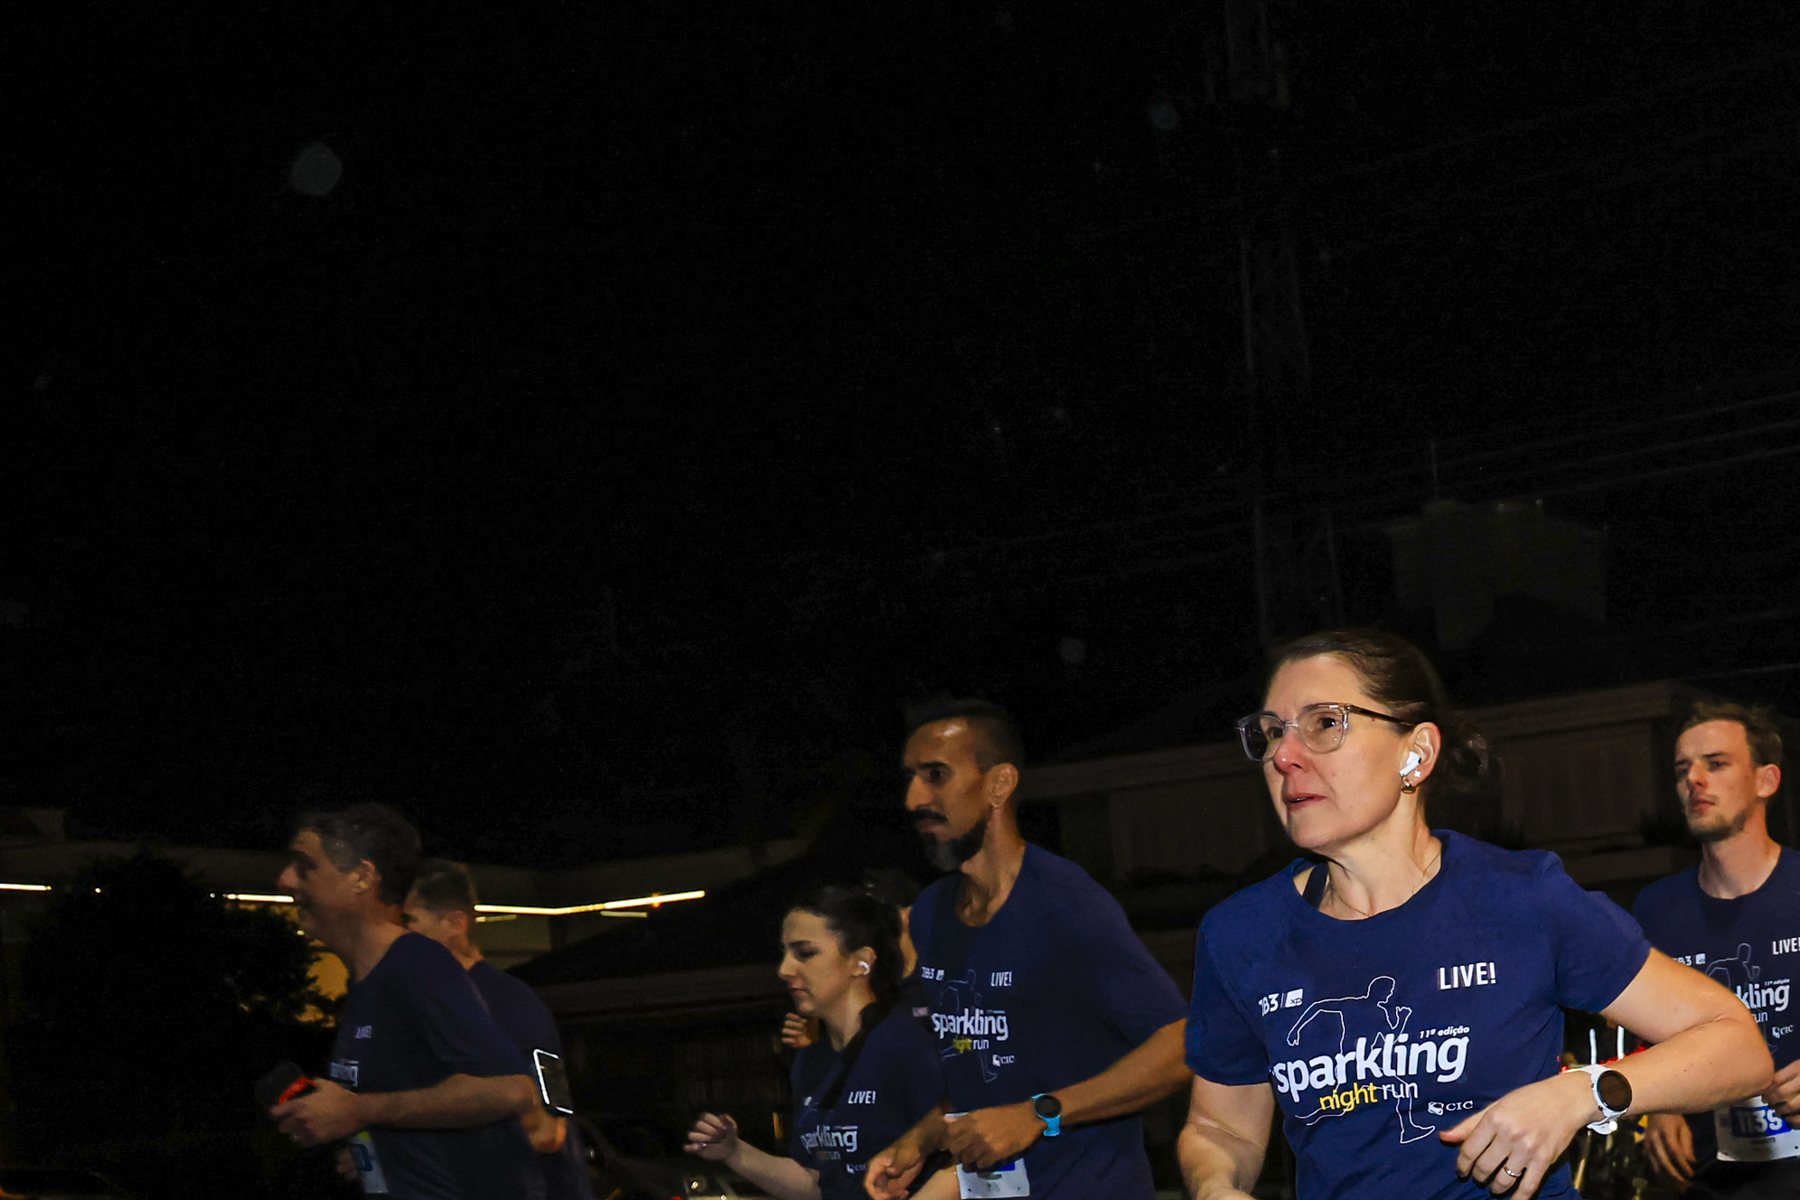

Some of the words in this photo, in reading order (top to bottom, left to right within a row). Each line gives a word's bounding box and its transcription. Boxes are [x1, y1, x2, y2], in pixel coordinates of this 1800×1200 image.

[991, 971, 1012, 987] LIVE!
[1439, 962, 1497, 990] LIVE!
[931, 1007, 1009, 1041] sparkling
[1437, 1025, 1470, 1037] edição
[973, 1039, 989, 1049] run
[1273, 1034, 1470, 1102] sparkling
[847, 1090, 876, 1104] LIVE!
[1320, 1082, 1378, 1112] night
[1383, 1082, 1418, 1100] run
[1446, 1100, 1474, 1111] CIC
